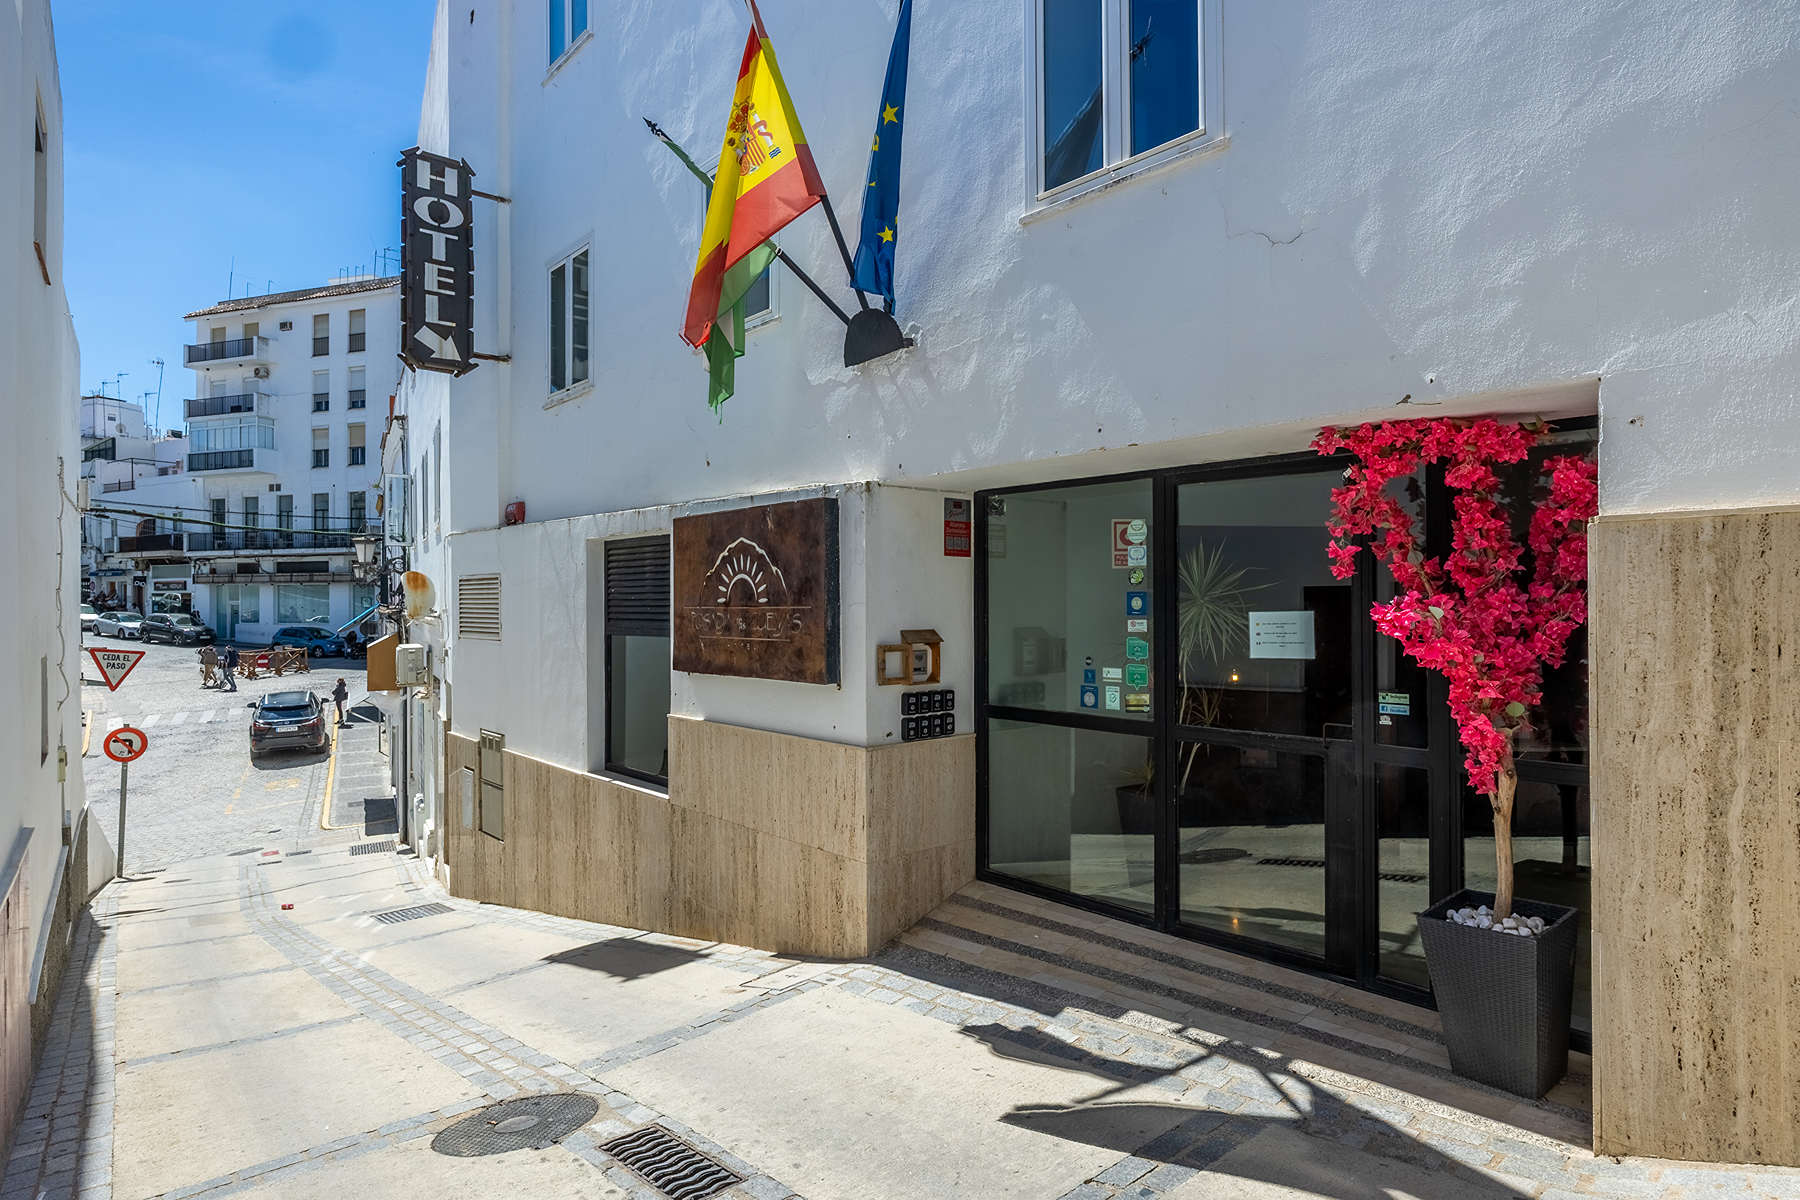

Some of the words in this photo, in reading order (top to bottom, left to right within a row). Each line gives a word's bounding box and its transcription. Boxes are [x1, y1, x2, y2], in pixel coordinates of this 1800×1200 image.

[413, 158, 465, 328] HOTEL
[102, 653, 121, 662] CEDA
[122, 654, 132, 662] EL
[106, 662, 126, 670] PASO
